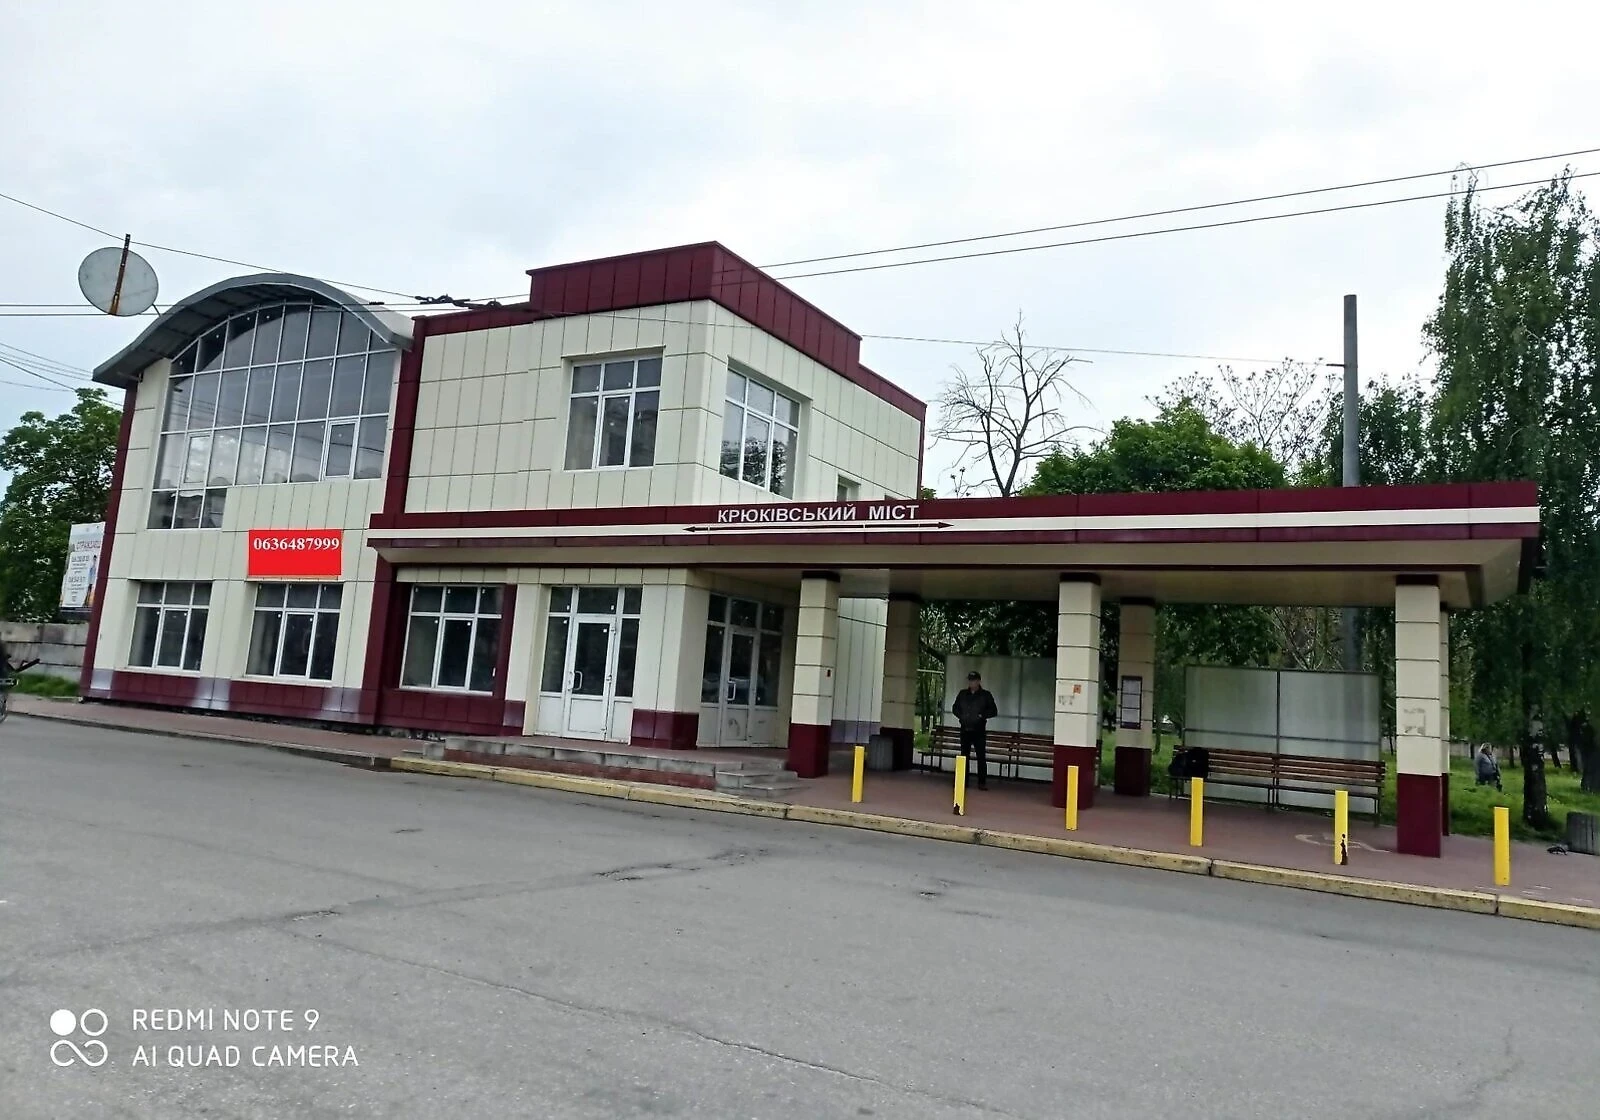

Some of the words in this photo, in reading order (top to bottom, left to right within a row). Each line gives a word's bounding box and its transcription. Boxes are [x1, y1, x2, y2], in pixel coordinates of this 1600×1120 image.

[717, 503, 857, 523] КРЮКІВСЬКИЙ
[868, 504, 920, 520] МІСТ
[253, 537, 340, 551] 0636487999
